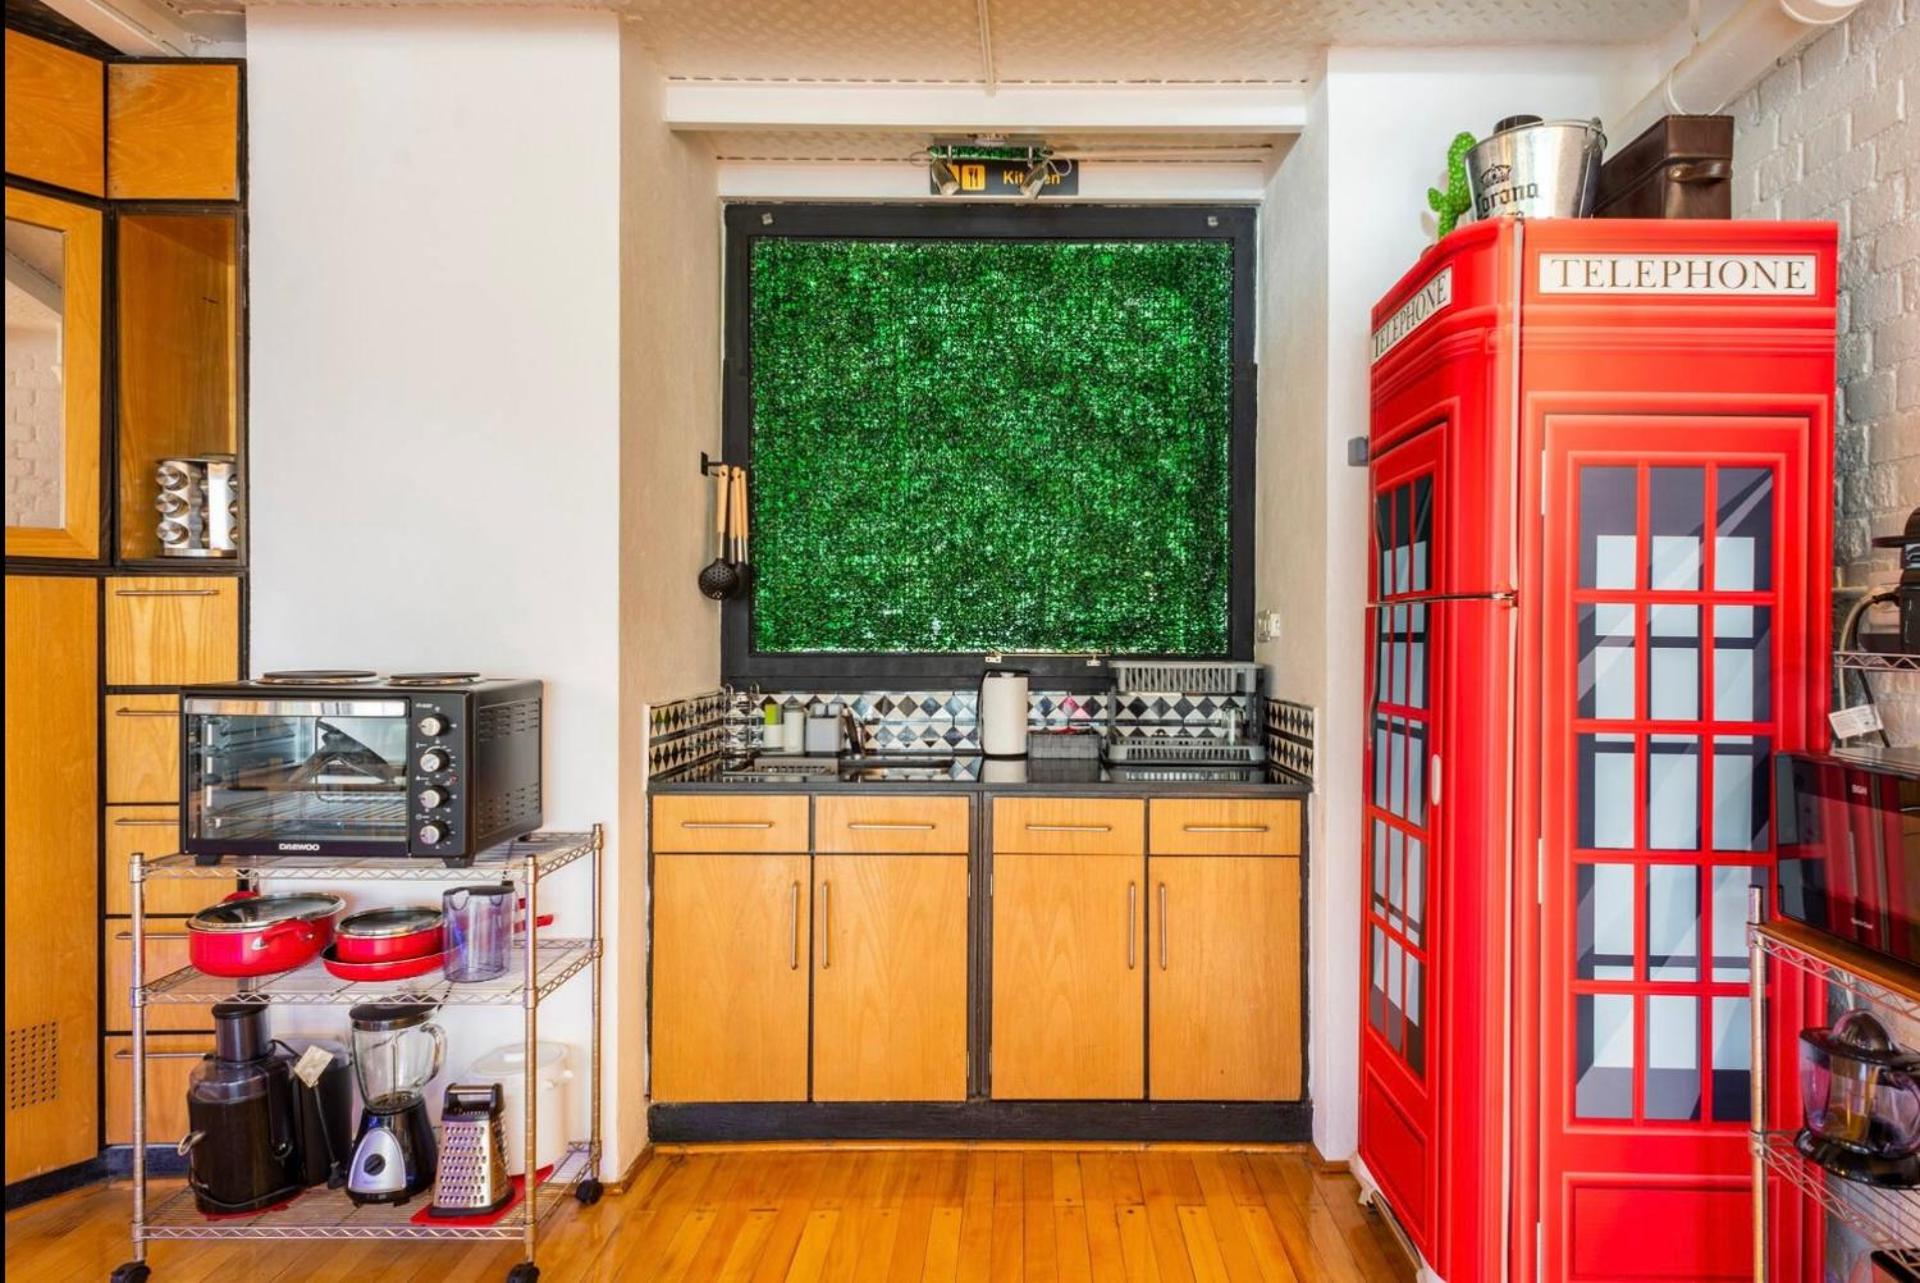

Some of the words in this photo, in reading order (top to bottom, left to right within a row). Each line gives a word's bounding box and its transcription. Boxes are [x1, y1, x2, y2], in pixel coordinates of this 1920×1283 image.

[1003, 170, 1061, 185] Kiten
[1551, 258, 1808, 290] TELEPHONE
[1374, 274, 1447, 358] TELEPHONE
